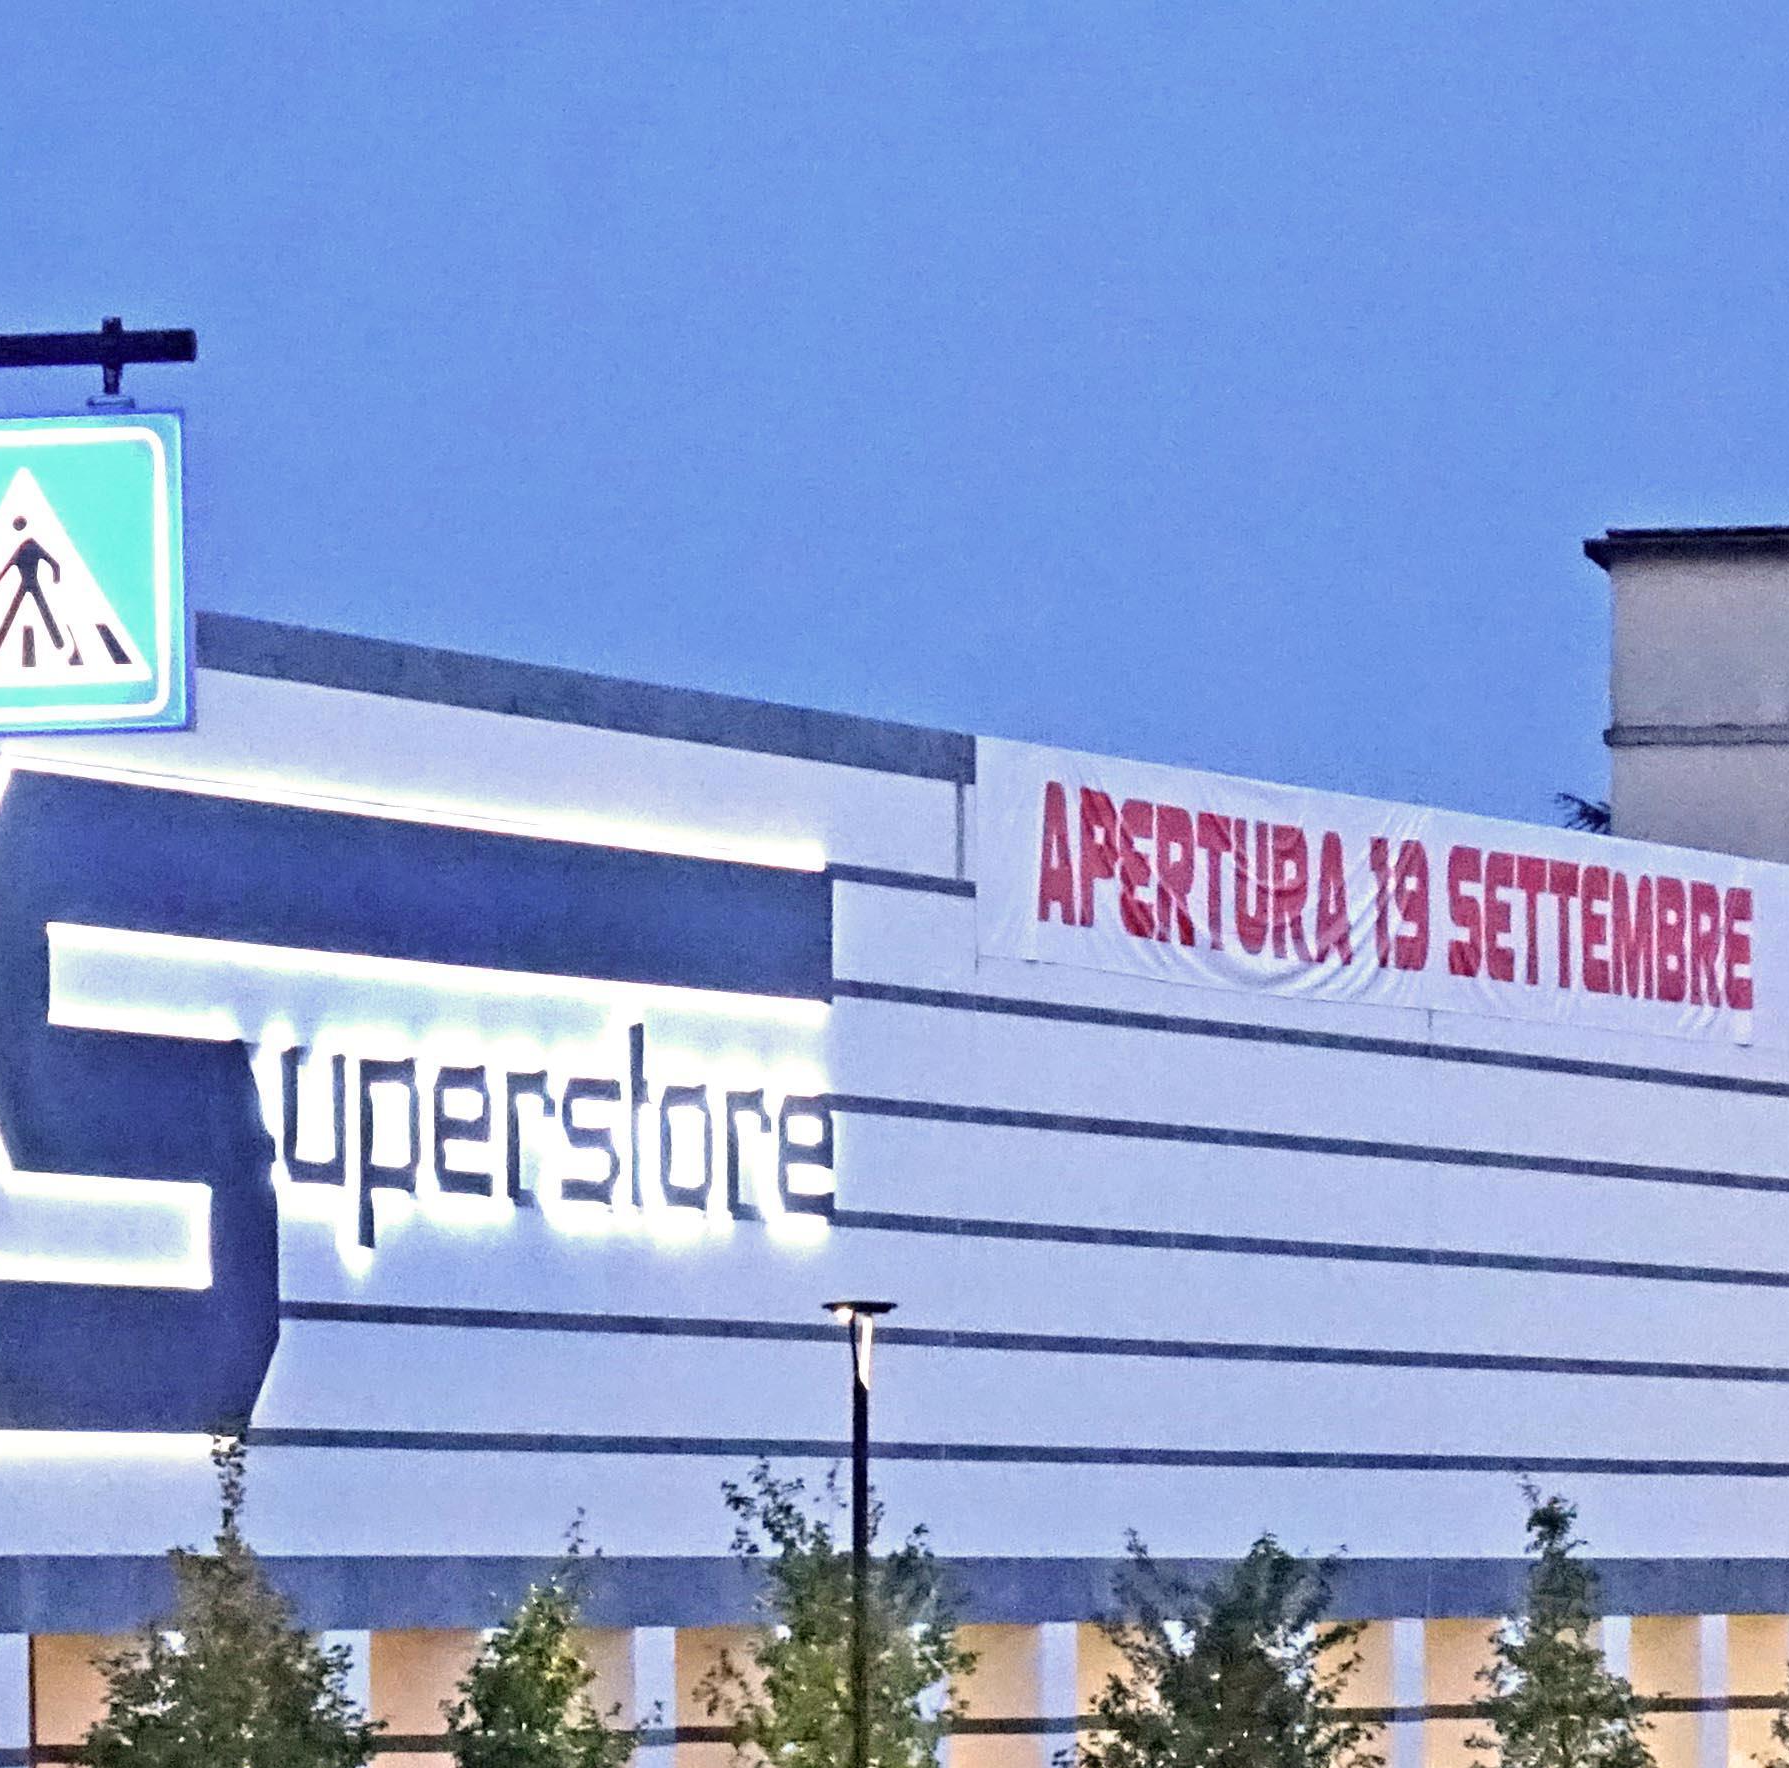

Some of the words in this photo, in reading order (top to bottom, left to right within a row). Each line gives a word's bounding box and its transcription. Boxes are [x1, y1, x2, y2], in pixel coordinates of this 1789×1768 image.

[1038, 780, 1353, 965] APERTURA
[1370, 836, 1429, 970] 19
[1447, 845, 1754, 1010] SETTEMBRE
